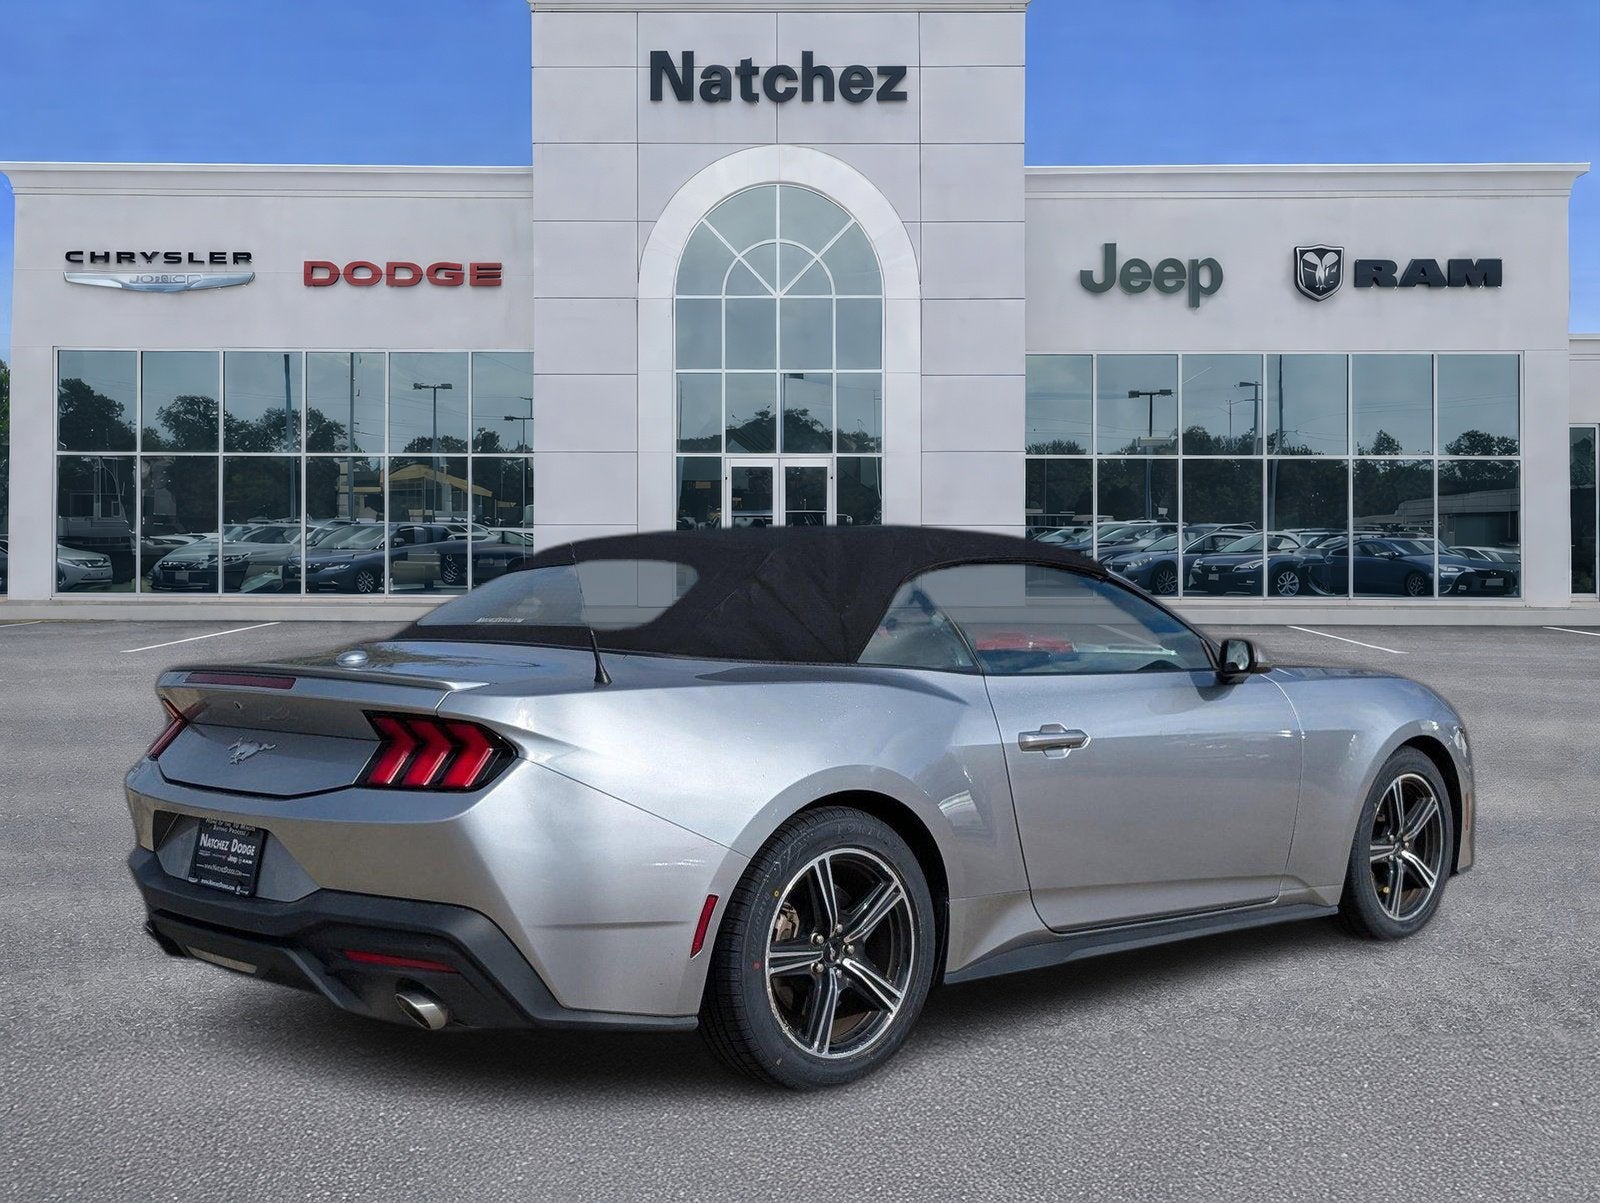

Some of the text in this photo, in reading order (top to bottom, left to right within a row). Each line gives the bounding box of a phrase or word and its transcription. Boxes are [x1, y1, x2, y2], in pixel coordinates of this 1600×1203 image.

[650, 50, 908, 103] Natchez
[64, 250, 252, 264] CHRYSLER
[303, 261, 503, 287] DODGE
[1079, 243, 1224, 308] Jeep
[1354, 258, 1503, 289] RAM
[199, 833, 230, 851] NATCHEZ
[231, 839, 256, 855] DODGE
